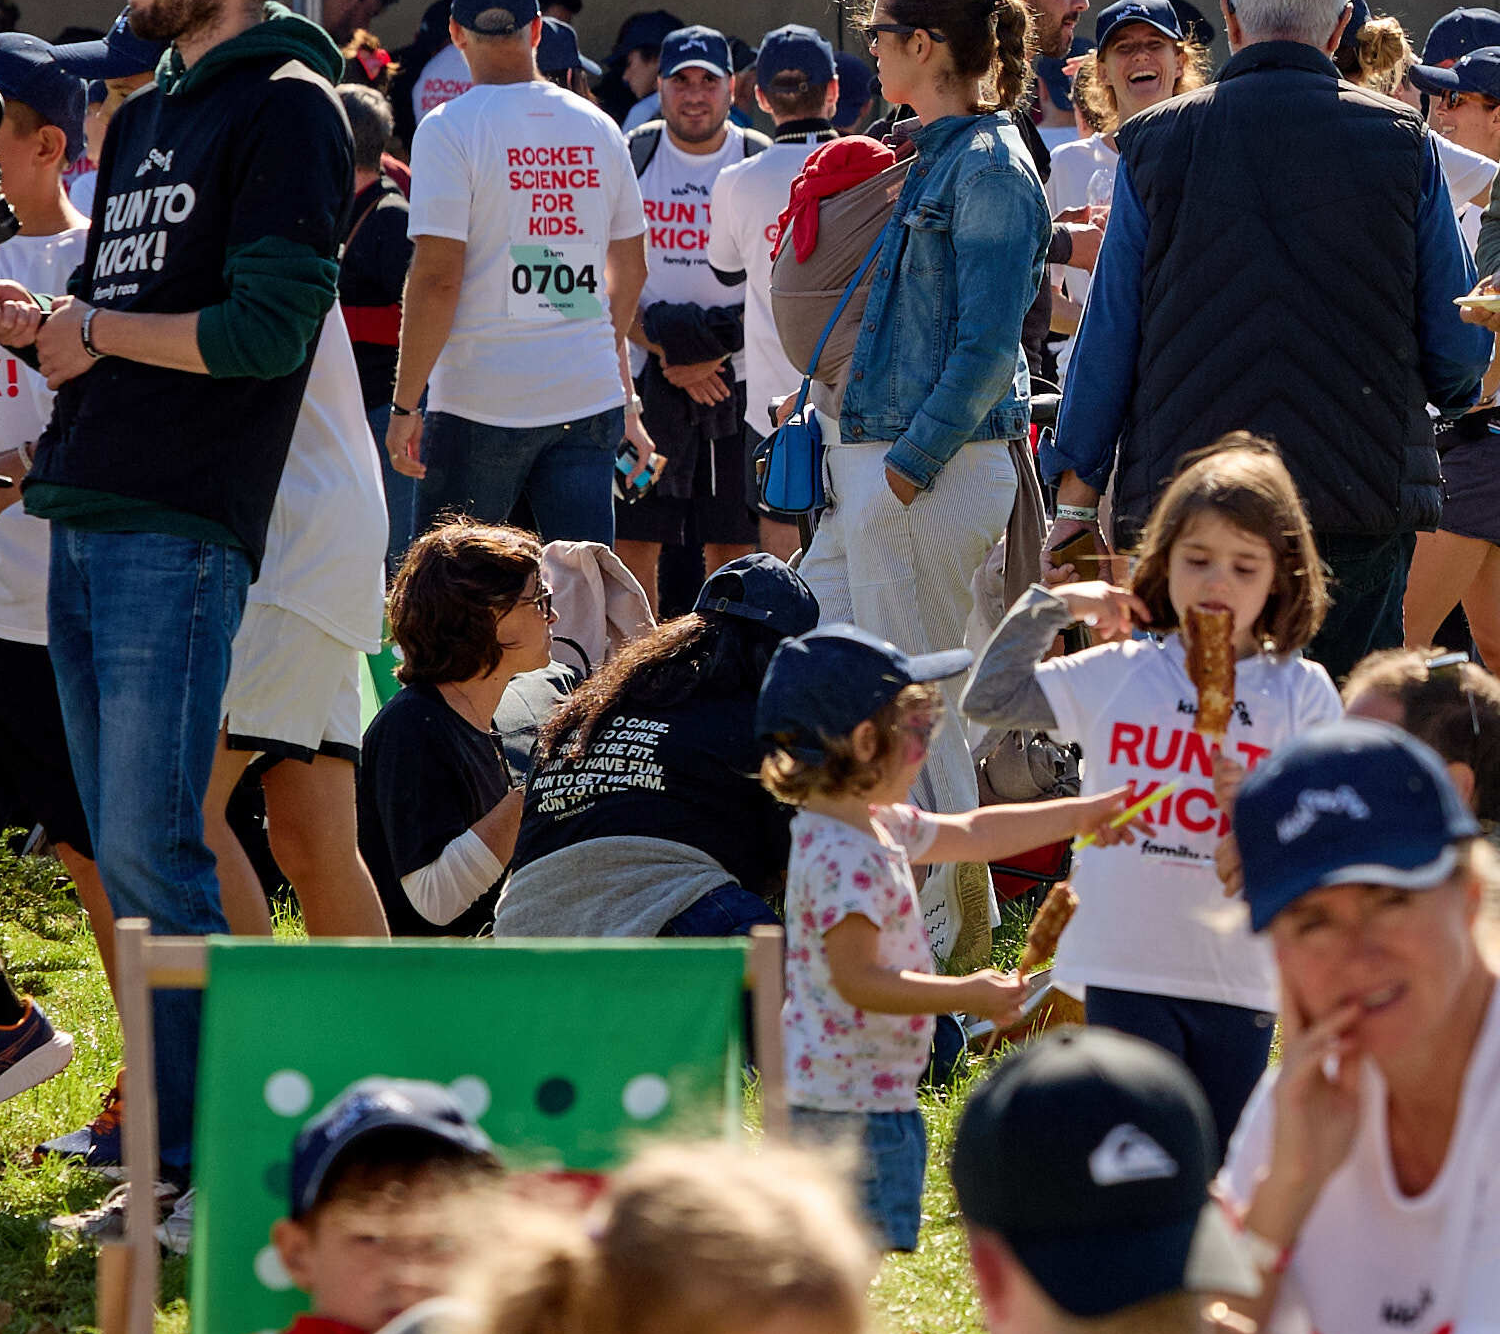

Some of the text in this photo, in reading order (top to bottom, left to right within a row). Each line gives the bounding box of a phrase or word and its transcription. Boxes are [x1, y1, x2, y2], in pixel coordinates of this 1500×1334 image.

[507, 146, 596, 167] ROCKET
[508, 169, 601, 192] SCIENCE
[103, 182, 196, 233] RUN TO
[531, 192, 574, 213] FOR
[528, 216, 585, 237] KIDS.
[92, 230, 168, 281] KICK!
[511, 264, 598, 296] 0704
[625, 717, 670, 734] CARE.
[616, 730, 660, 746] CURE.
[606, 742, 656, 762] BE FIT.
[1108, 720, 1272, 778] RUN T
[584, 756, 626, 772] HAVE
[532, 772, 666, 791] RUN TO GET WARM.
